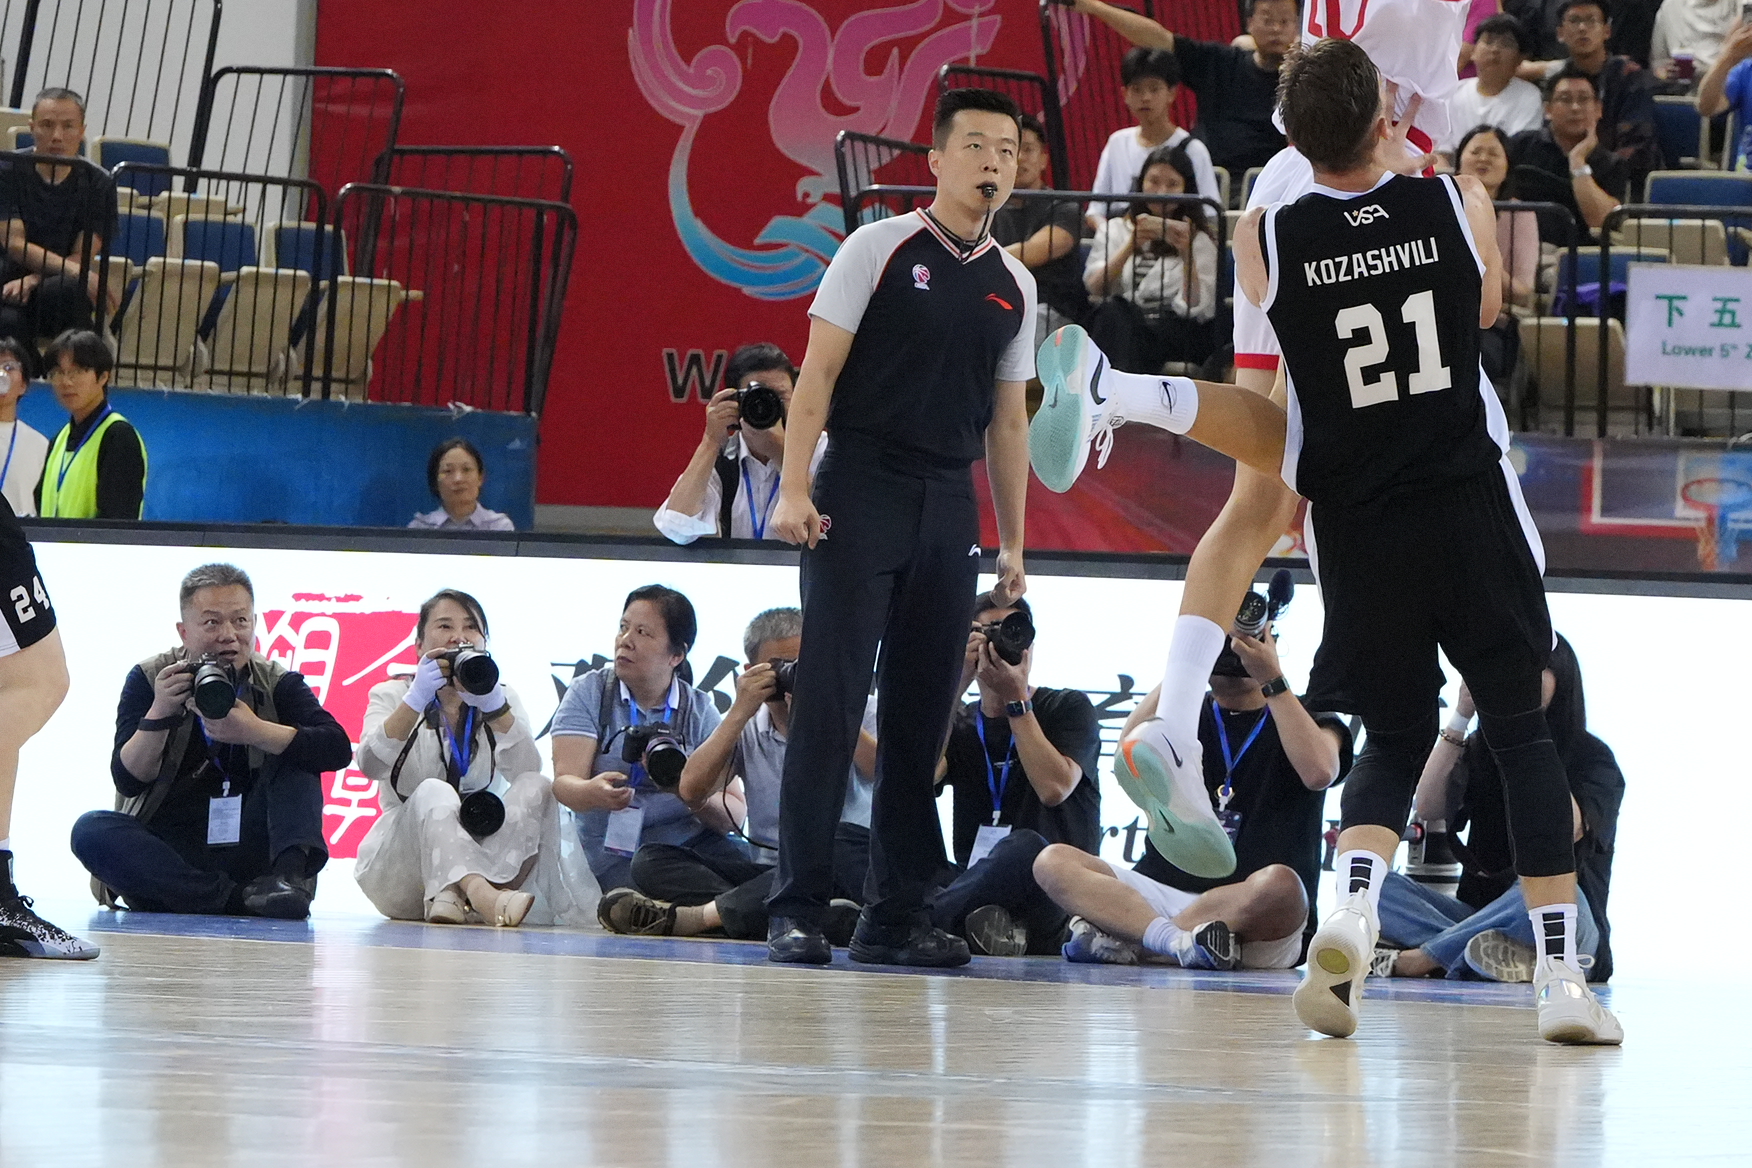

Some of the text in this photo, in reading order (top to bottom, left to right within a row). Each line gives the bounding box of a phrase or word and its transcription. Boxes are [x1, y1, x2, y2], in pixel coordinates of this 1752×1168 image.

[1304, 236, 1439, 287] KOZASHVILI
[1335, 289, 1452, 409] 21
[1661, 341, 1716, 357] Lower
[1720, 343, 1739, 358] 5th
[10, 575, 50, 624] 24
